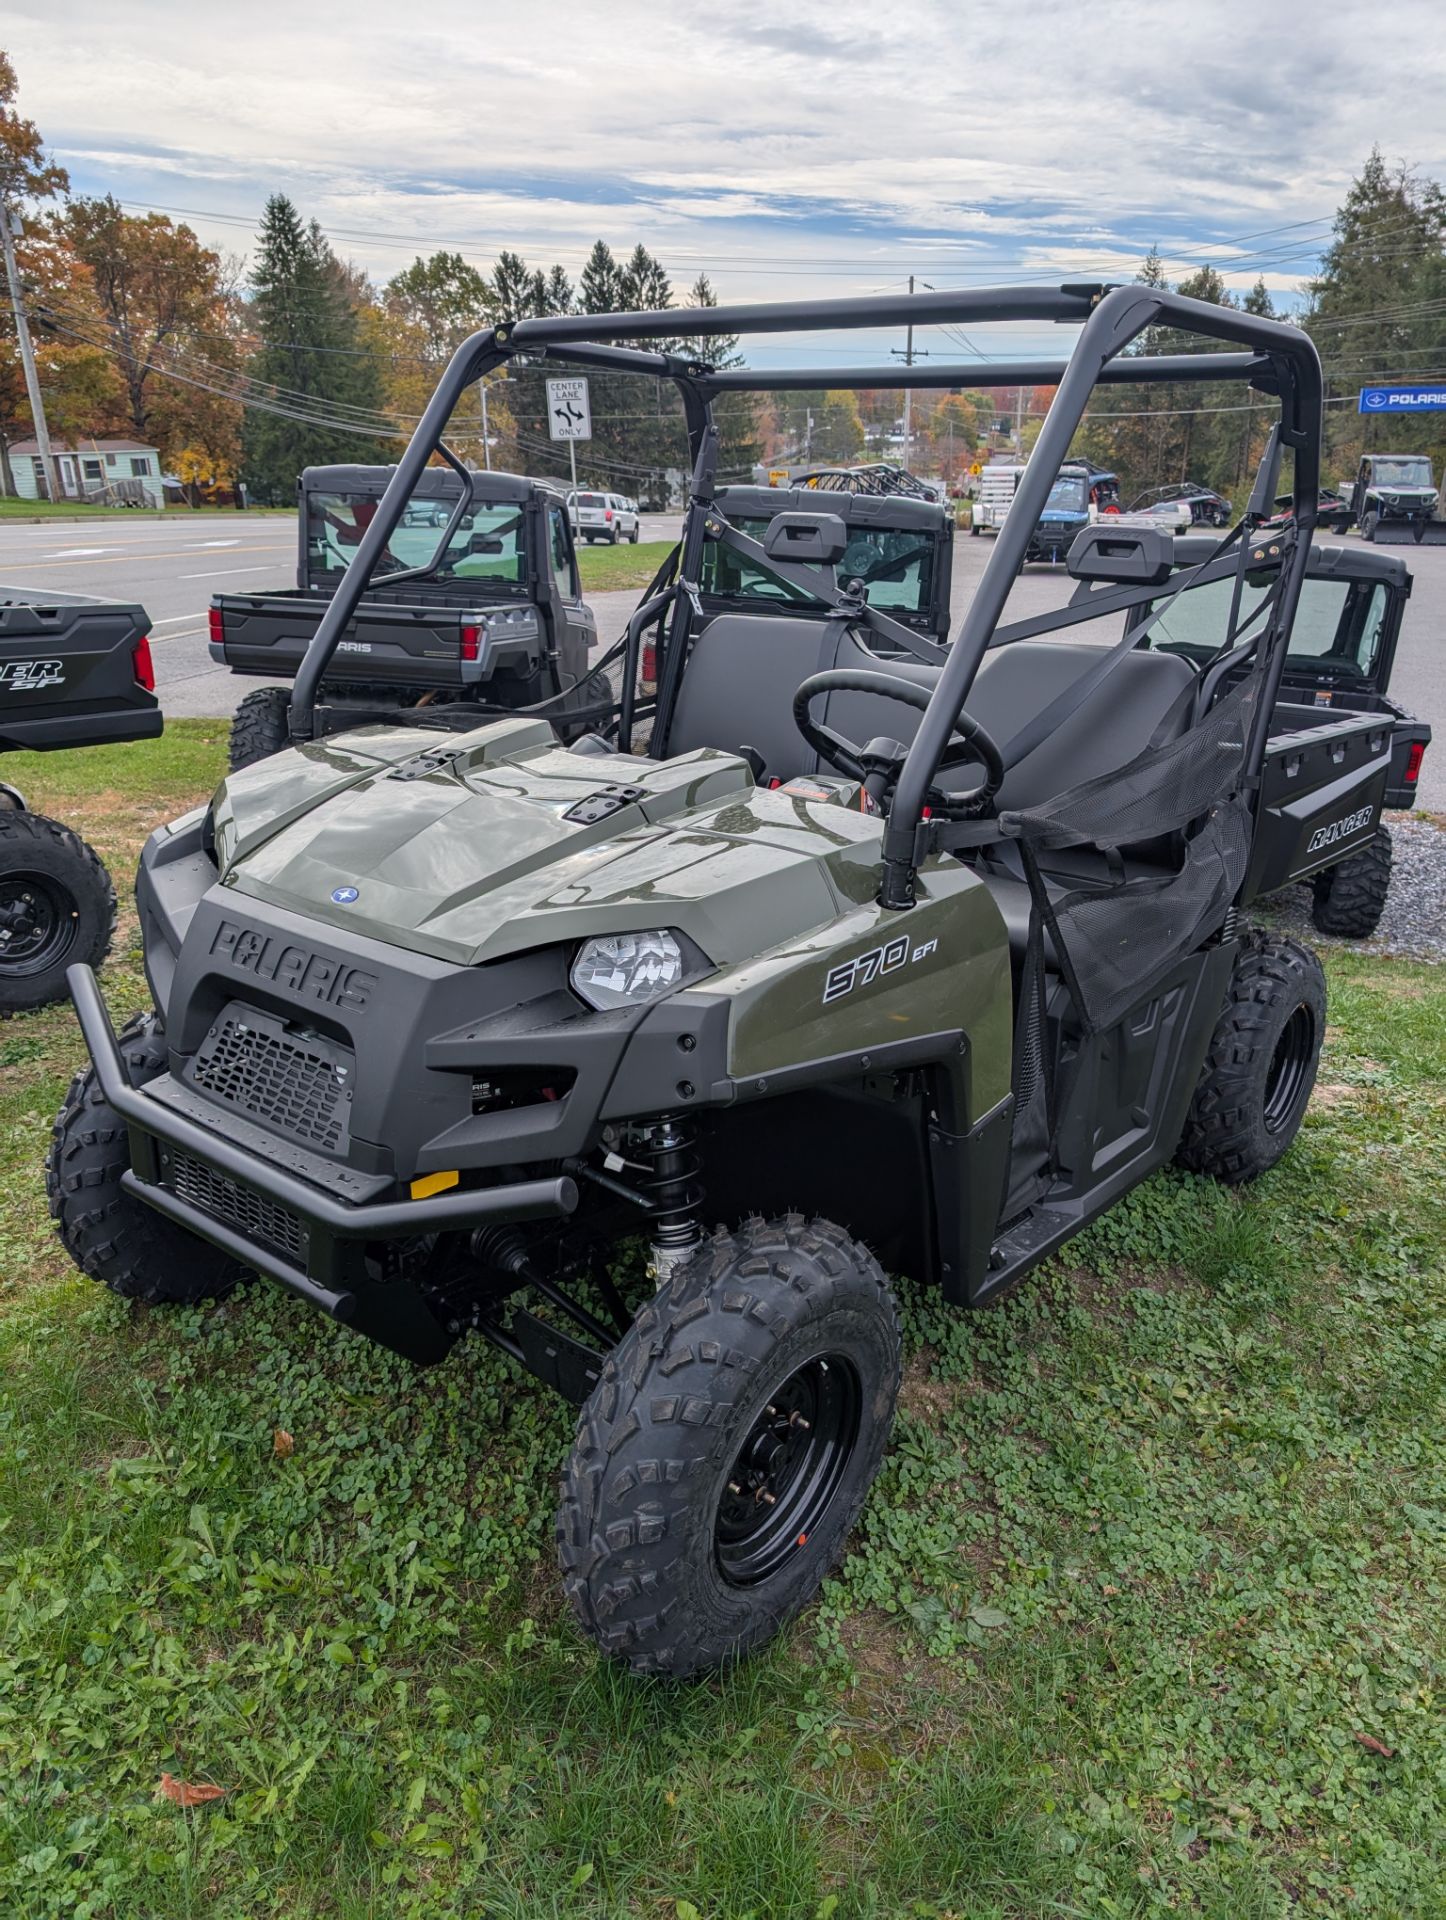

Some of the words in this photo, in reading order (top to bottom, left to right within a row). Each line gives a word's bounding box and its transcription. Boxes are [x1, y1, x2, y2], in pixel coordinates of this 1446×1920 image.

[550, 382, 583, 391] CENTER
[556, 391, 579, 399] LANE
[1389, 393, 1446, 405] POLARIS
[558, 428, 582, 436] ONLY
[9, 677, 66, 690] SP
[1306, 805, 1373, 853] RANGER
[209, 920, 380, 1015] POLARIS
[823, 934, 910, 1004] 570
[911, 938, 938, 963] EFI
